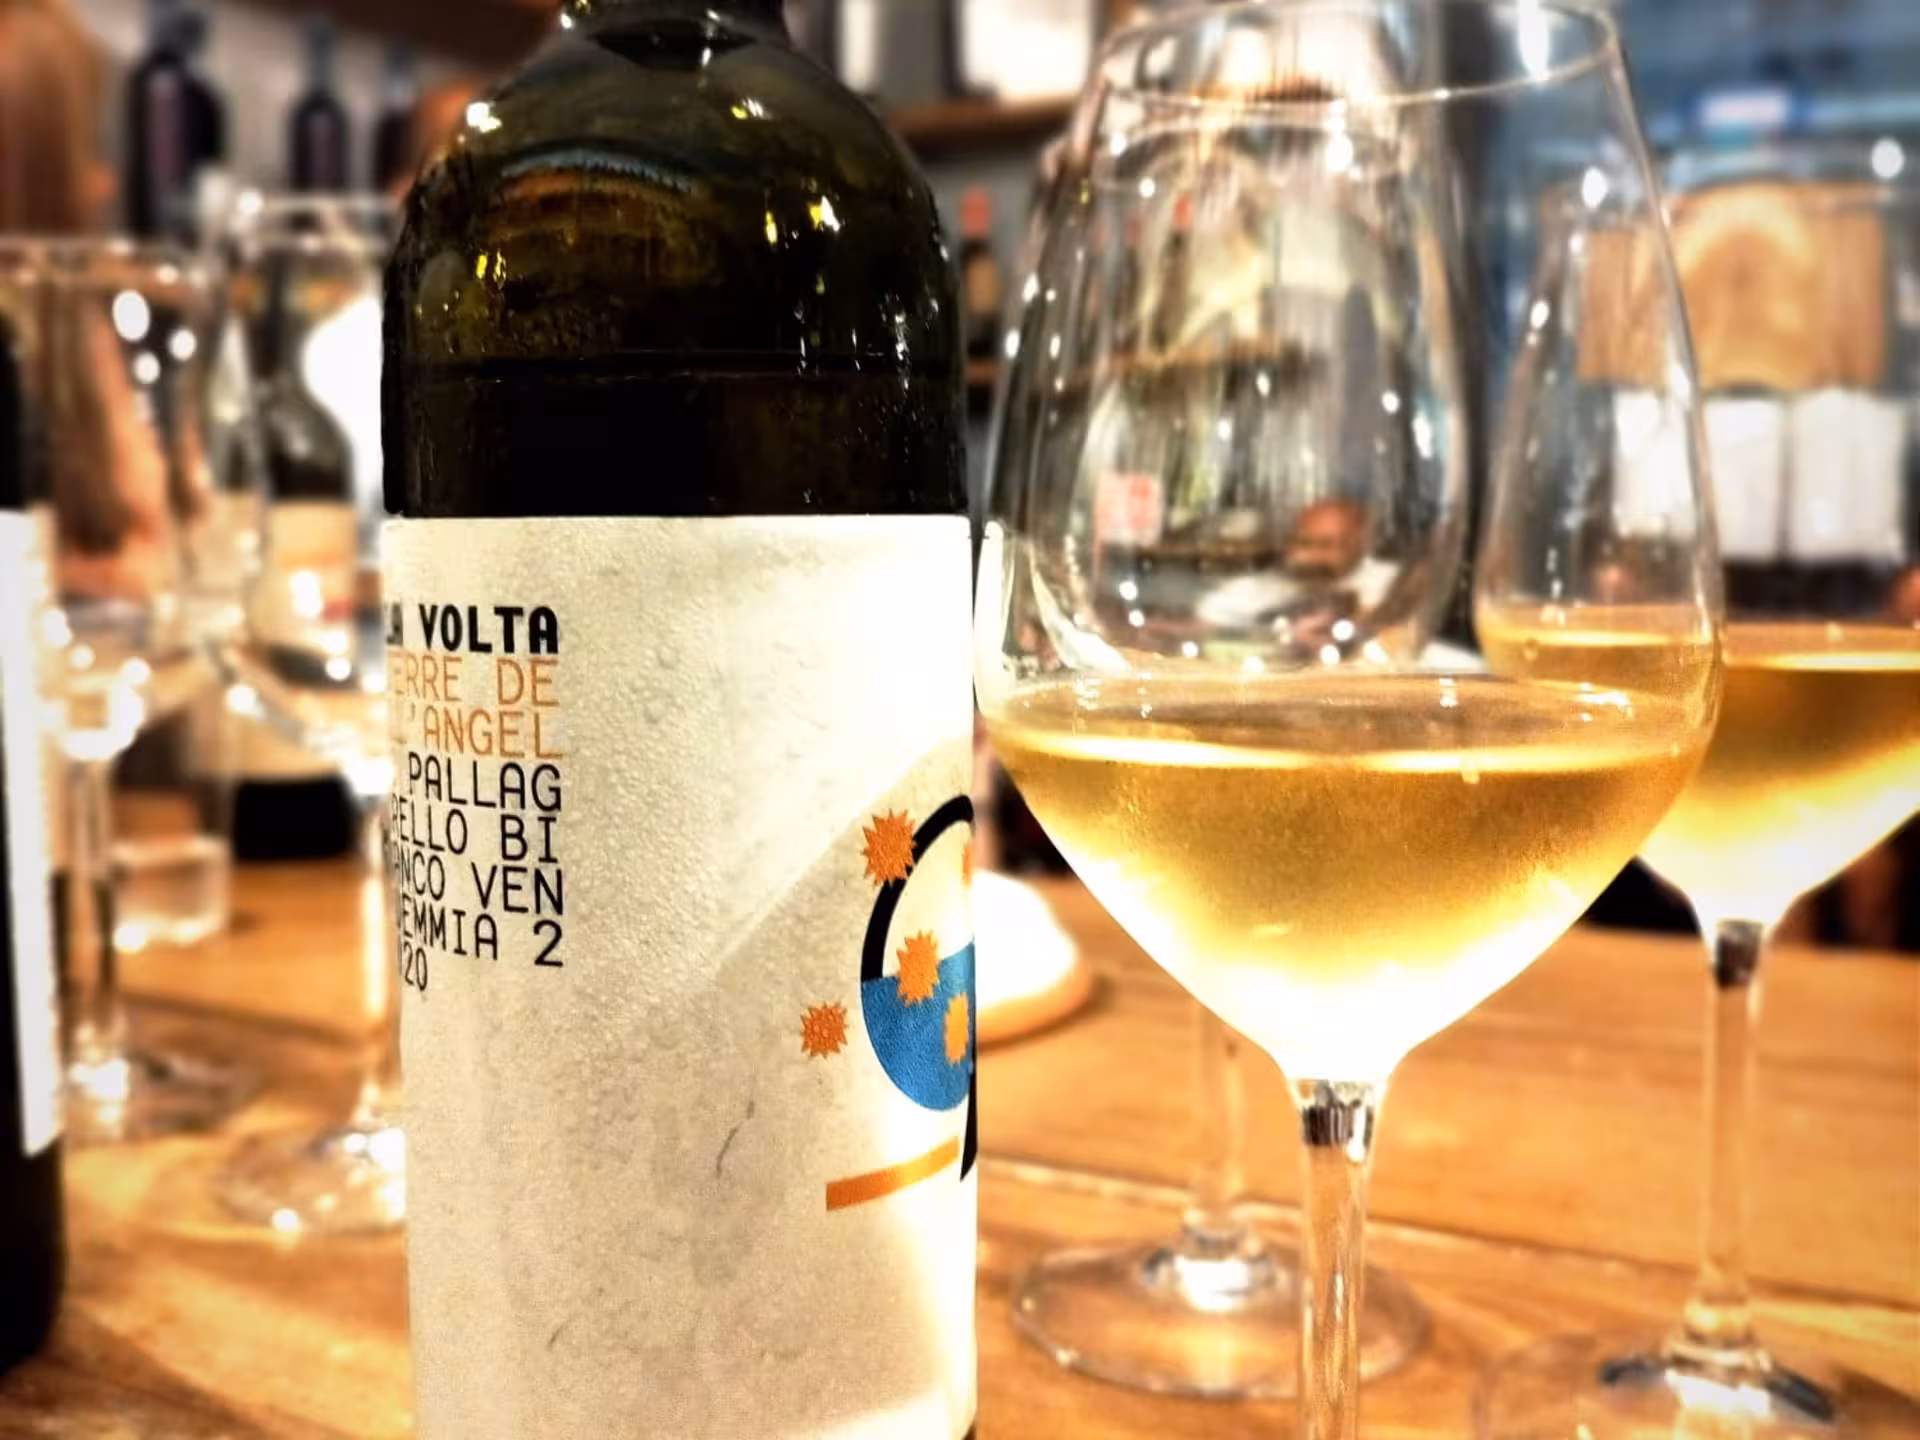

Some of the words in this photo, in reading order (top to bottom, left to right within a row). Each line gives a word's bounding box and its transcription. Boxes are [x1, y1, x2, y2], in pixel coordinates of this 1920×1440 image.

[418, 603, 559, 655] VOLTA
[496, 658, 560, 707] DE
[408, 750, 562, 813] PALLAG
[500, 814, 558, 864] BI
[470, 861, 564, 916] VEN
[396, 892, 498, 961] EMMIA
[532, 919, 564, 968] 2
[397, 937, 428, 992] 20
